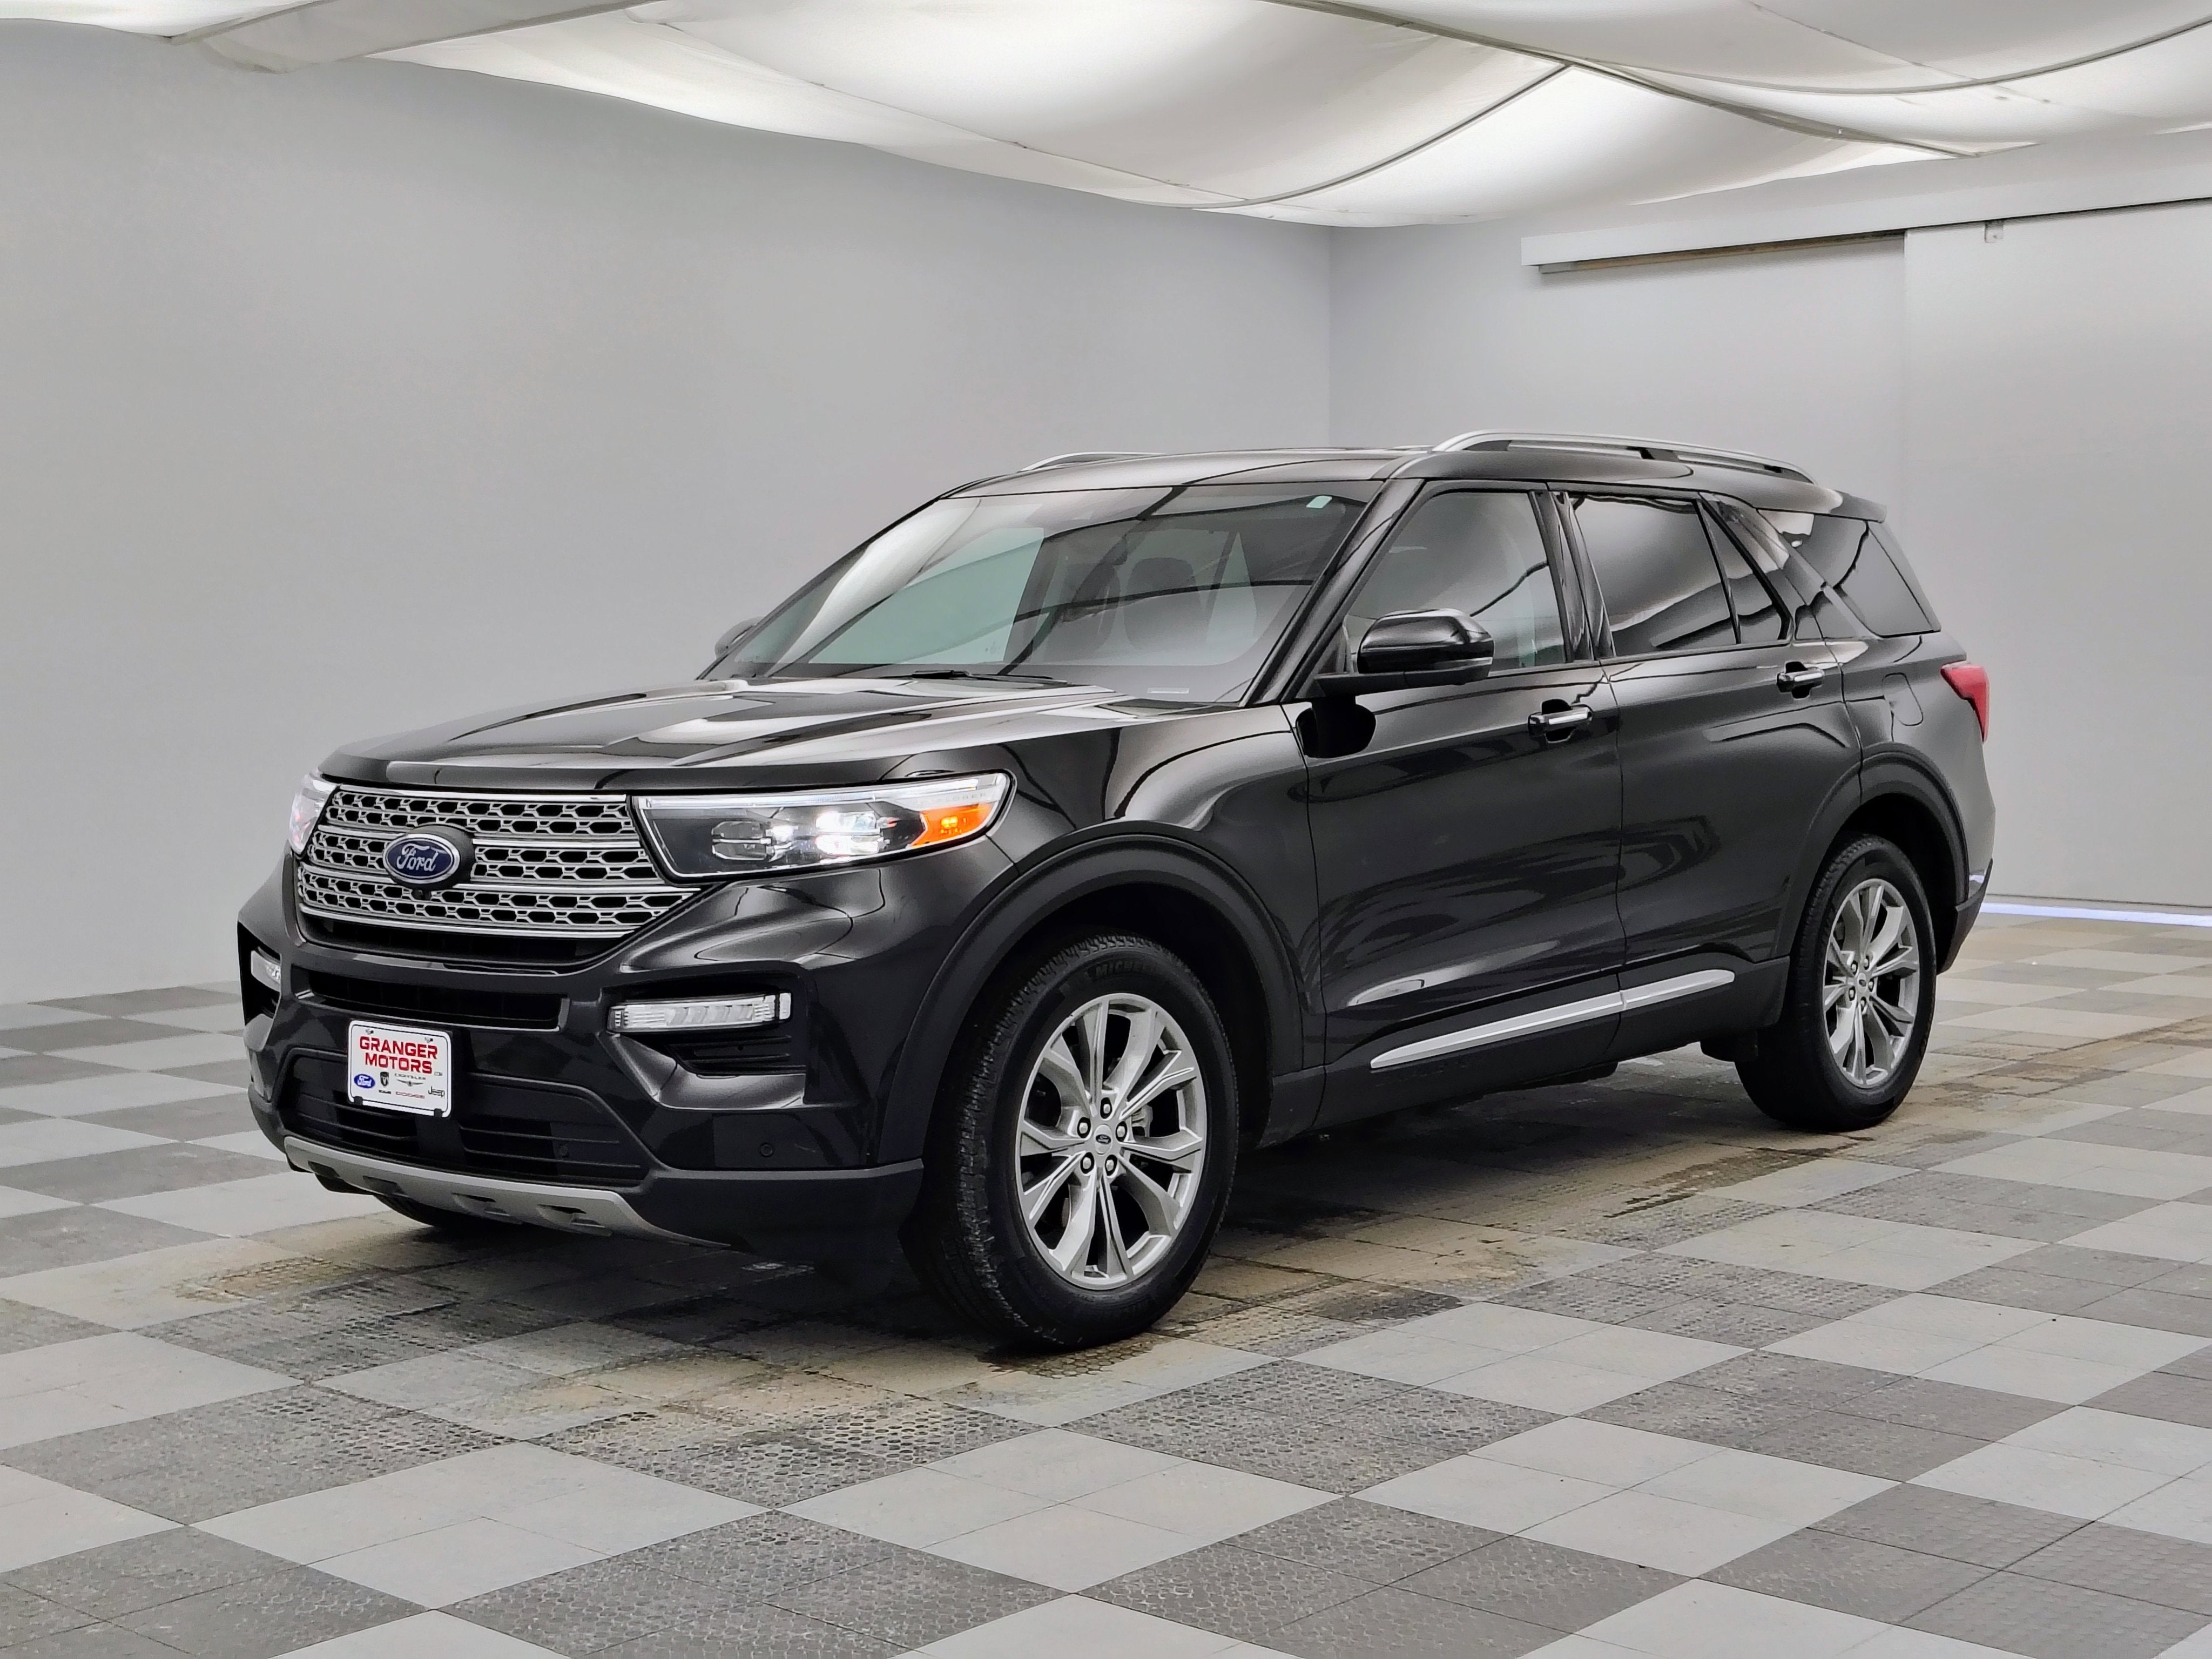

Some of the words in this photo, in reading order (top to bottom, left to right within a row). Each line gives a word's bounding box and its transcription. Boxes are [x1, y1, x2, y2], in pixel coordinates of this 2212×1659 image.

[397, 843, 439, 872] Ford
[360, 1036, 437, 1059] GRANGER
[366, 1053, 432, 1074] MOTORS
